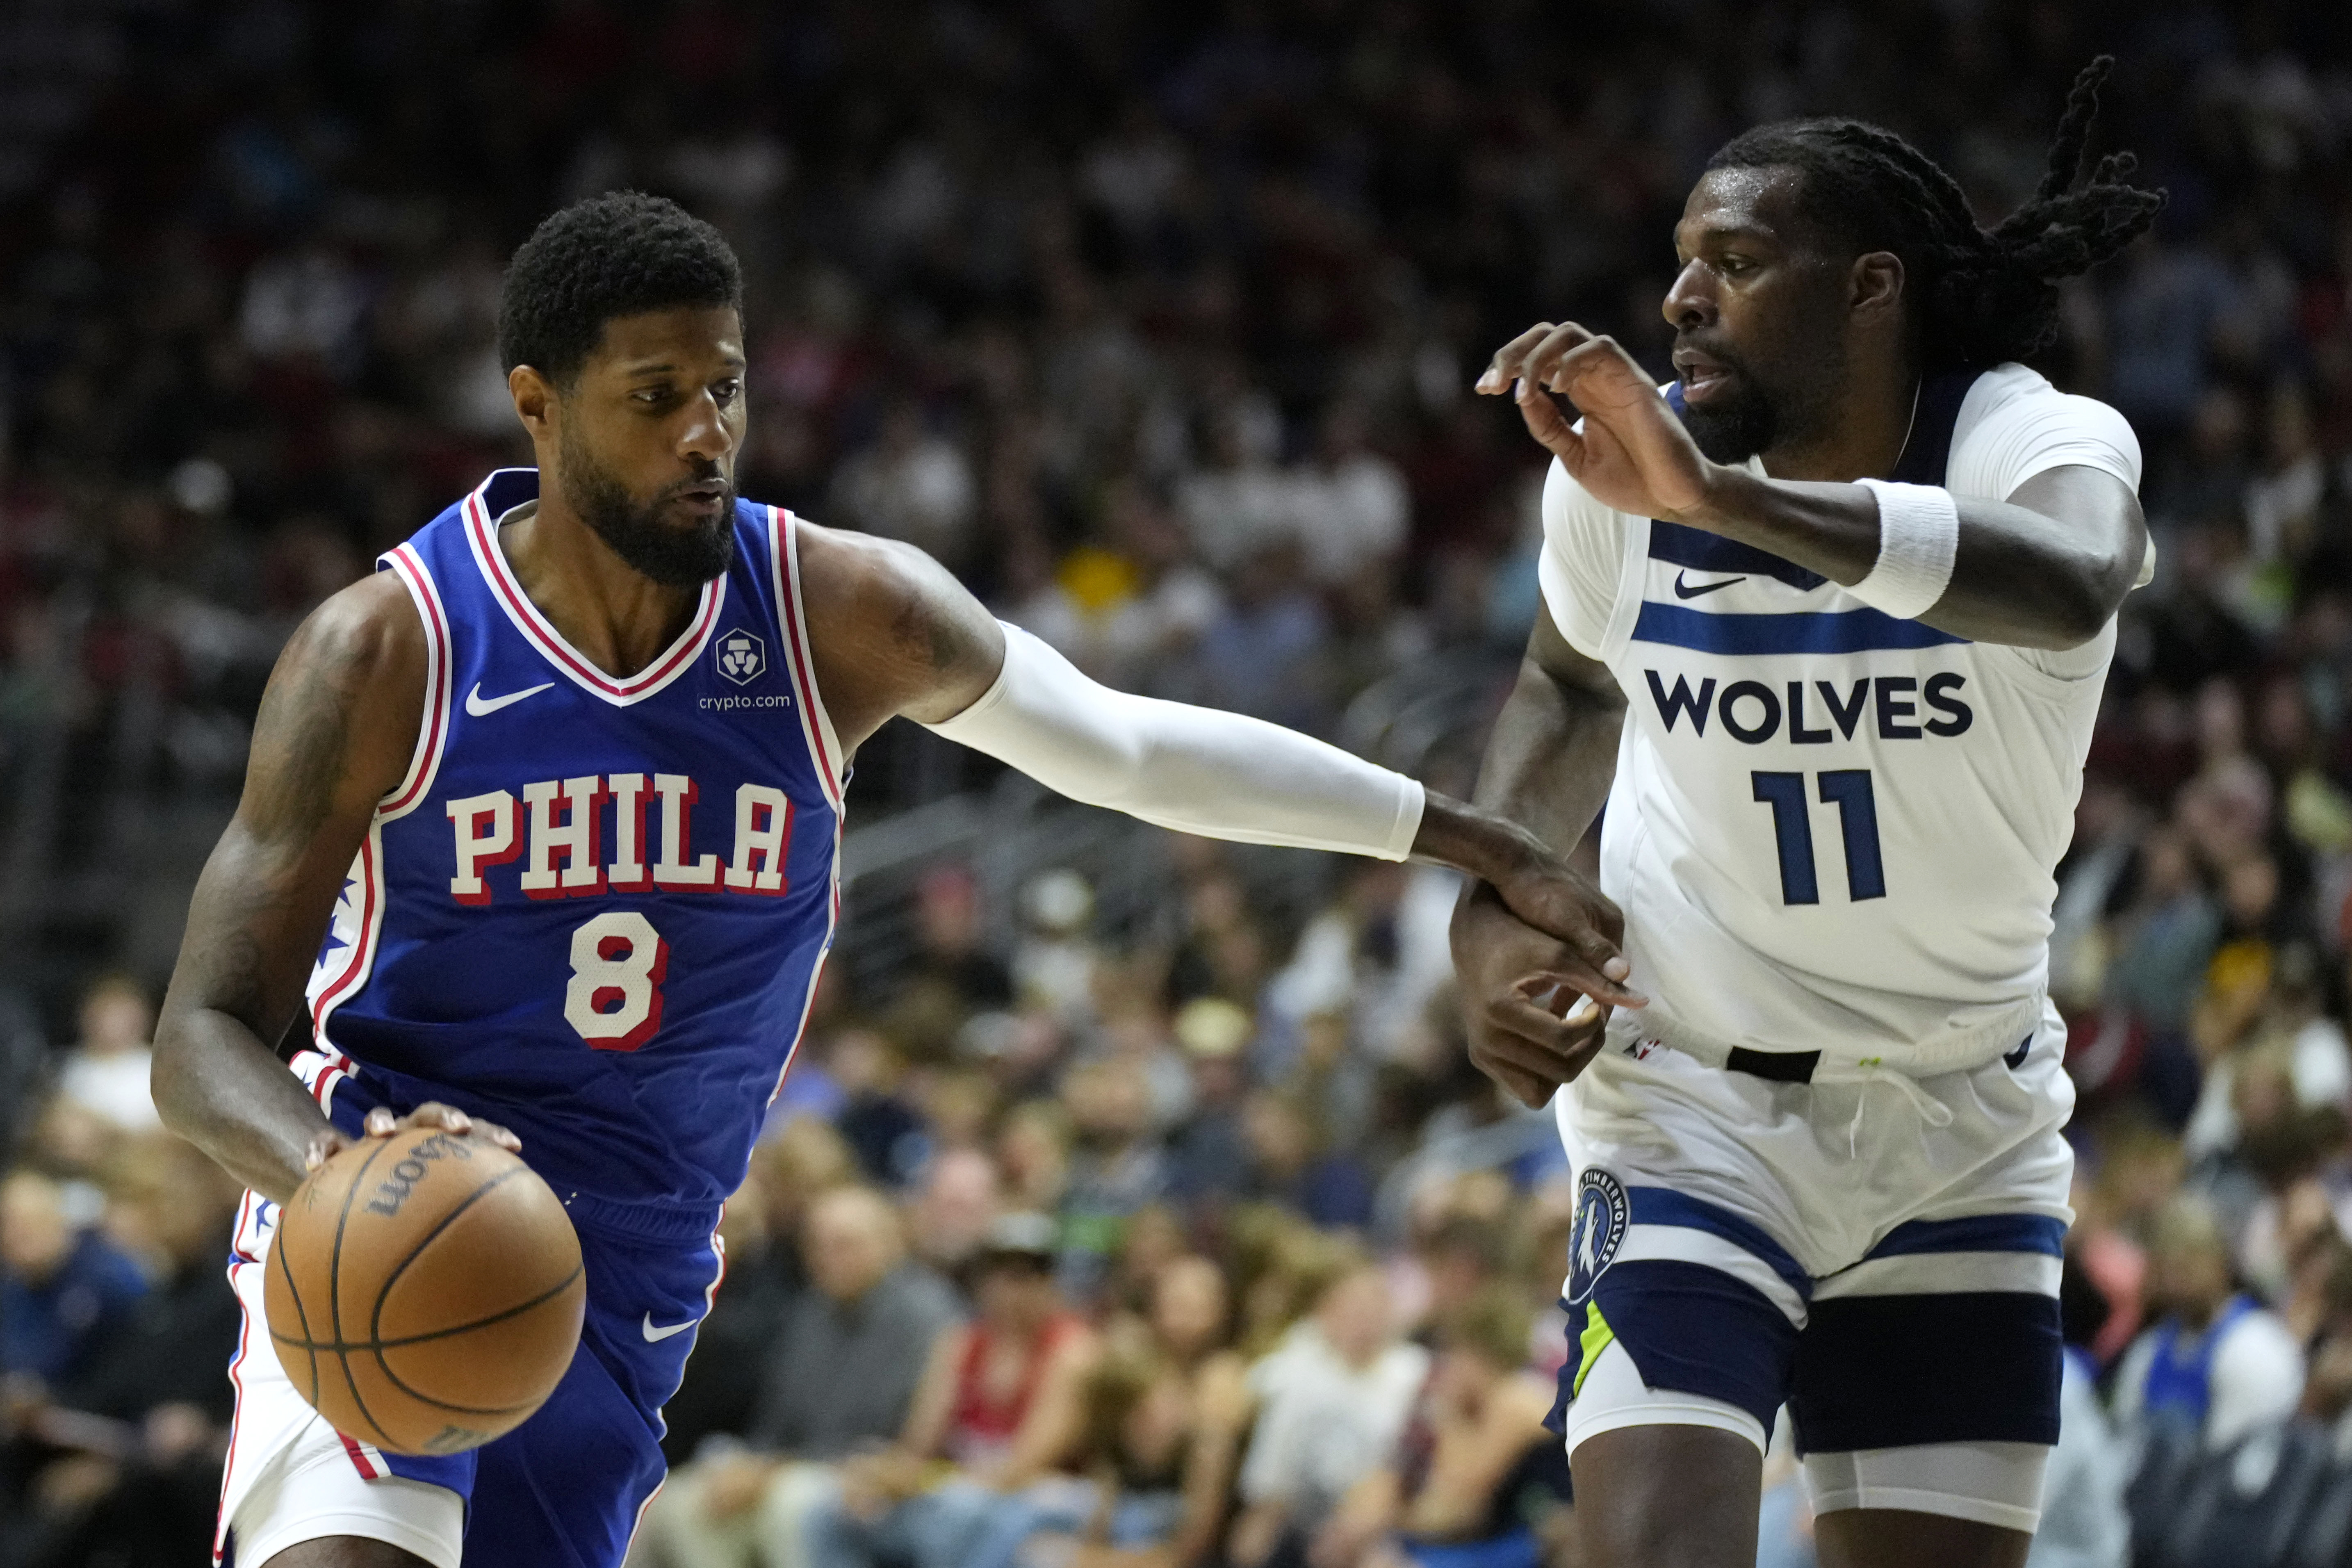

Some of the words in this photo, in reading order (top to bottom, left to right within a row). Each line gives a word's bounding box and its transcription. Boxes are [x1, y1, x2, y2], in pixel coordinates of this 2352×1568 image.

[700, 695, 790, 711] crypto.com
[1644, 669, 1973, 744] WOLVES
[446, 773, 794, 905] PHILA
[1751, 770, 1886, 905] 11
[564, 912, 670, 1051] 8
[1585, 1171, 1624, 1263] TIMBERWOLVES
